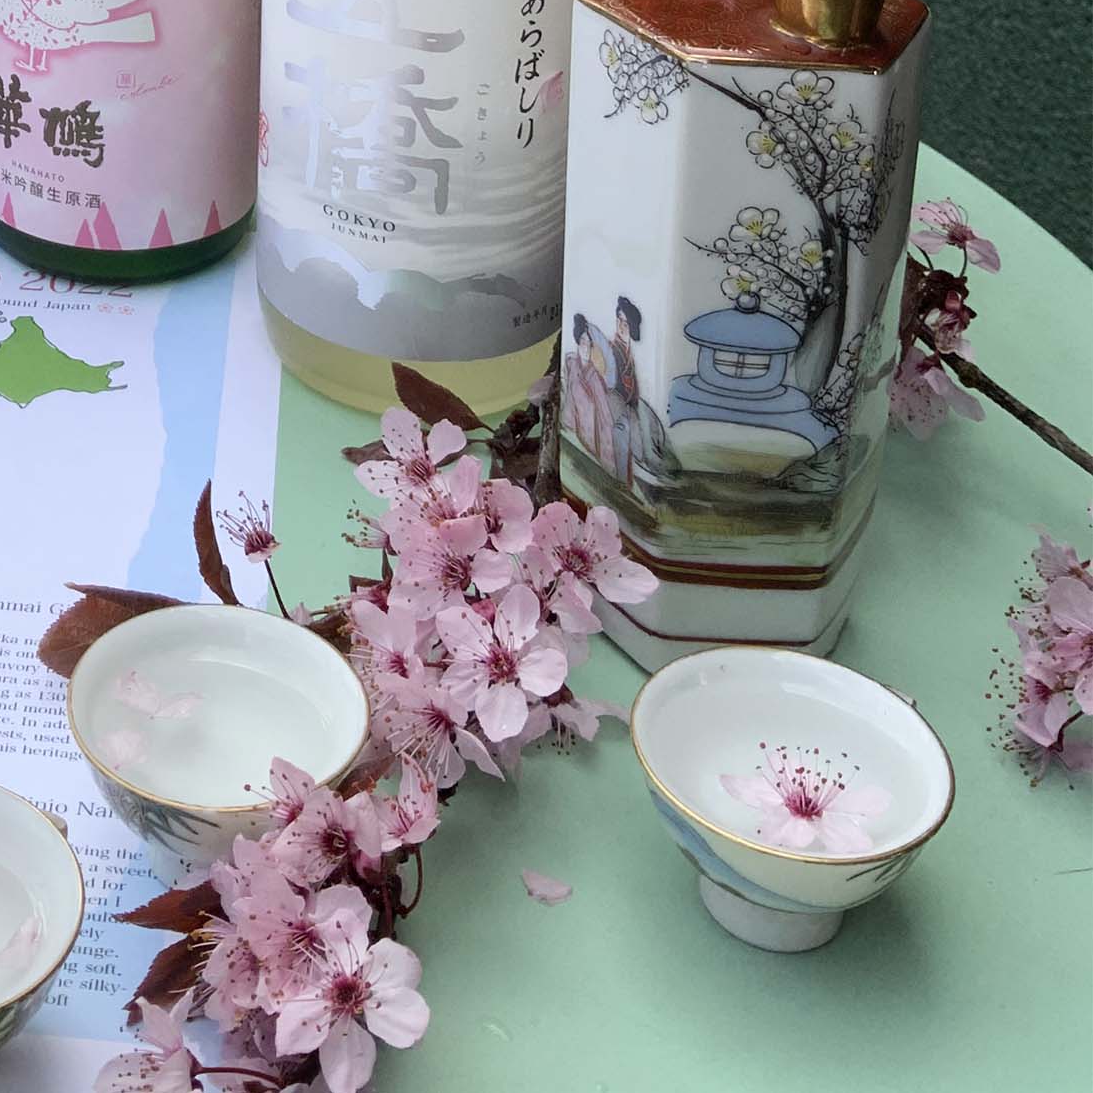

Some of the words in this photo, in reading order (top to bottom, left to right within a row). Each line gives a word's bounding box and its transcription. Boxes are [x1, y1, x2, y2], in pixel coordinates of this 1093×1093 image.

[11, 160, 65, 183] HANAHATO
[322, 203, 397, 233] GOKYO
[331, 222, 388, 244] JUNMAI
[43, 300, 91, 312] Japan
